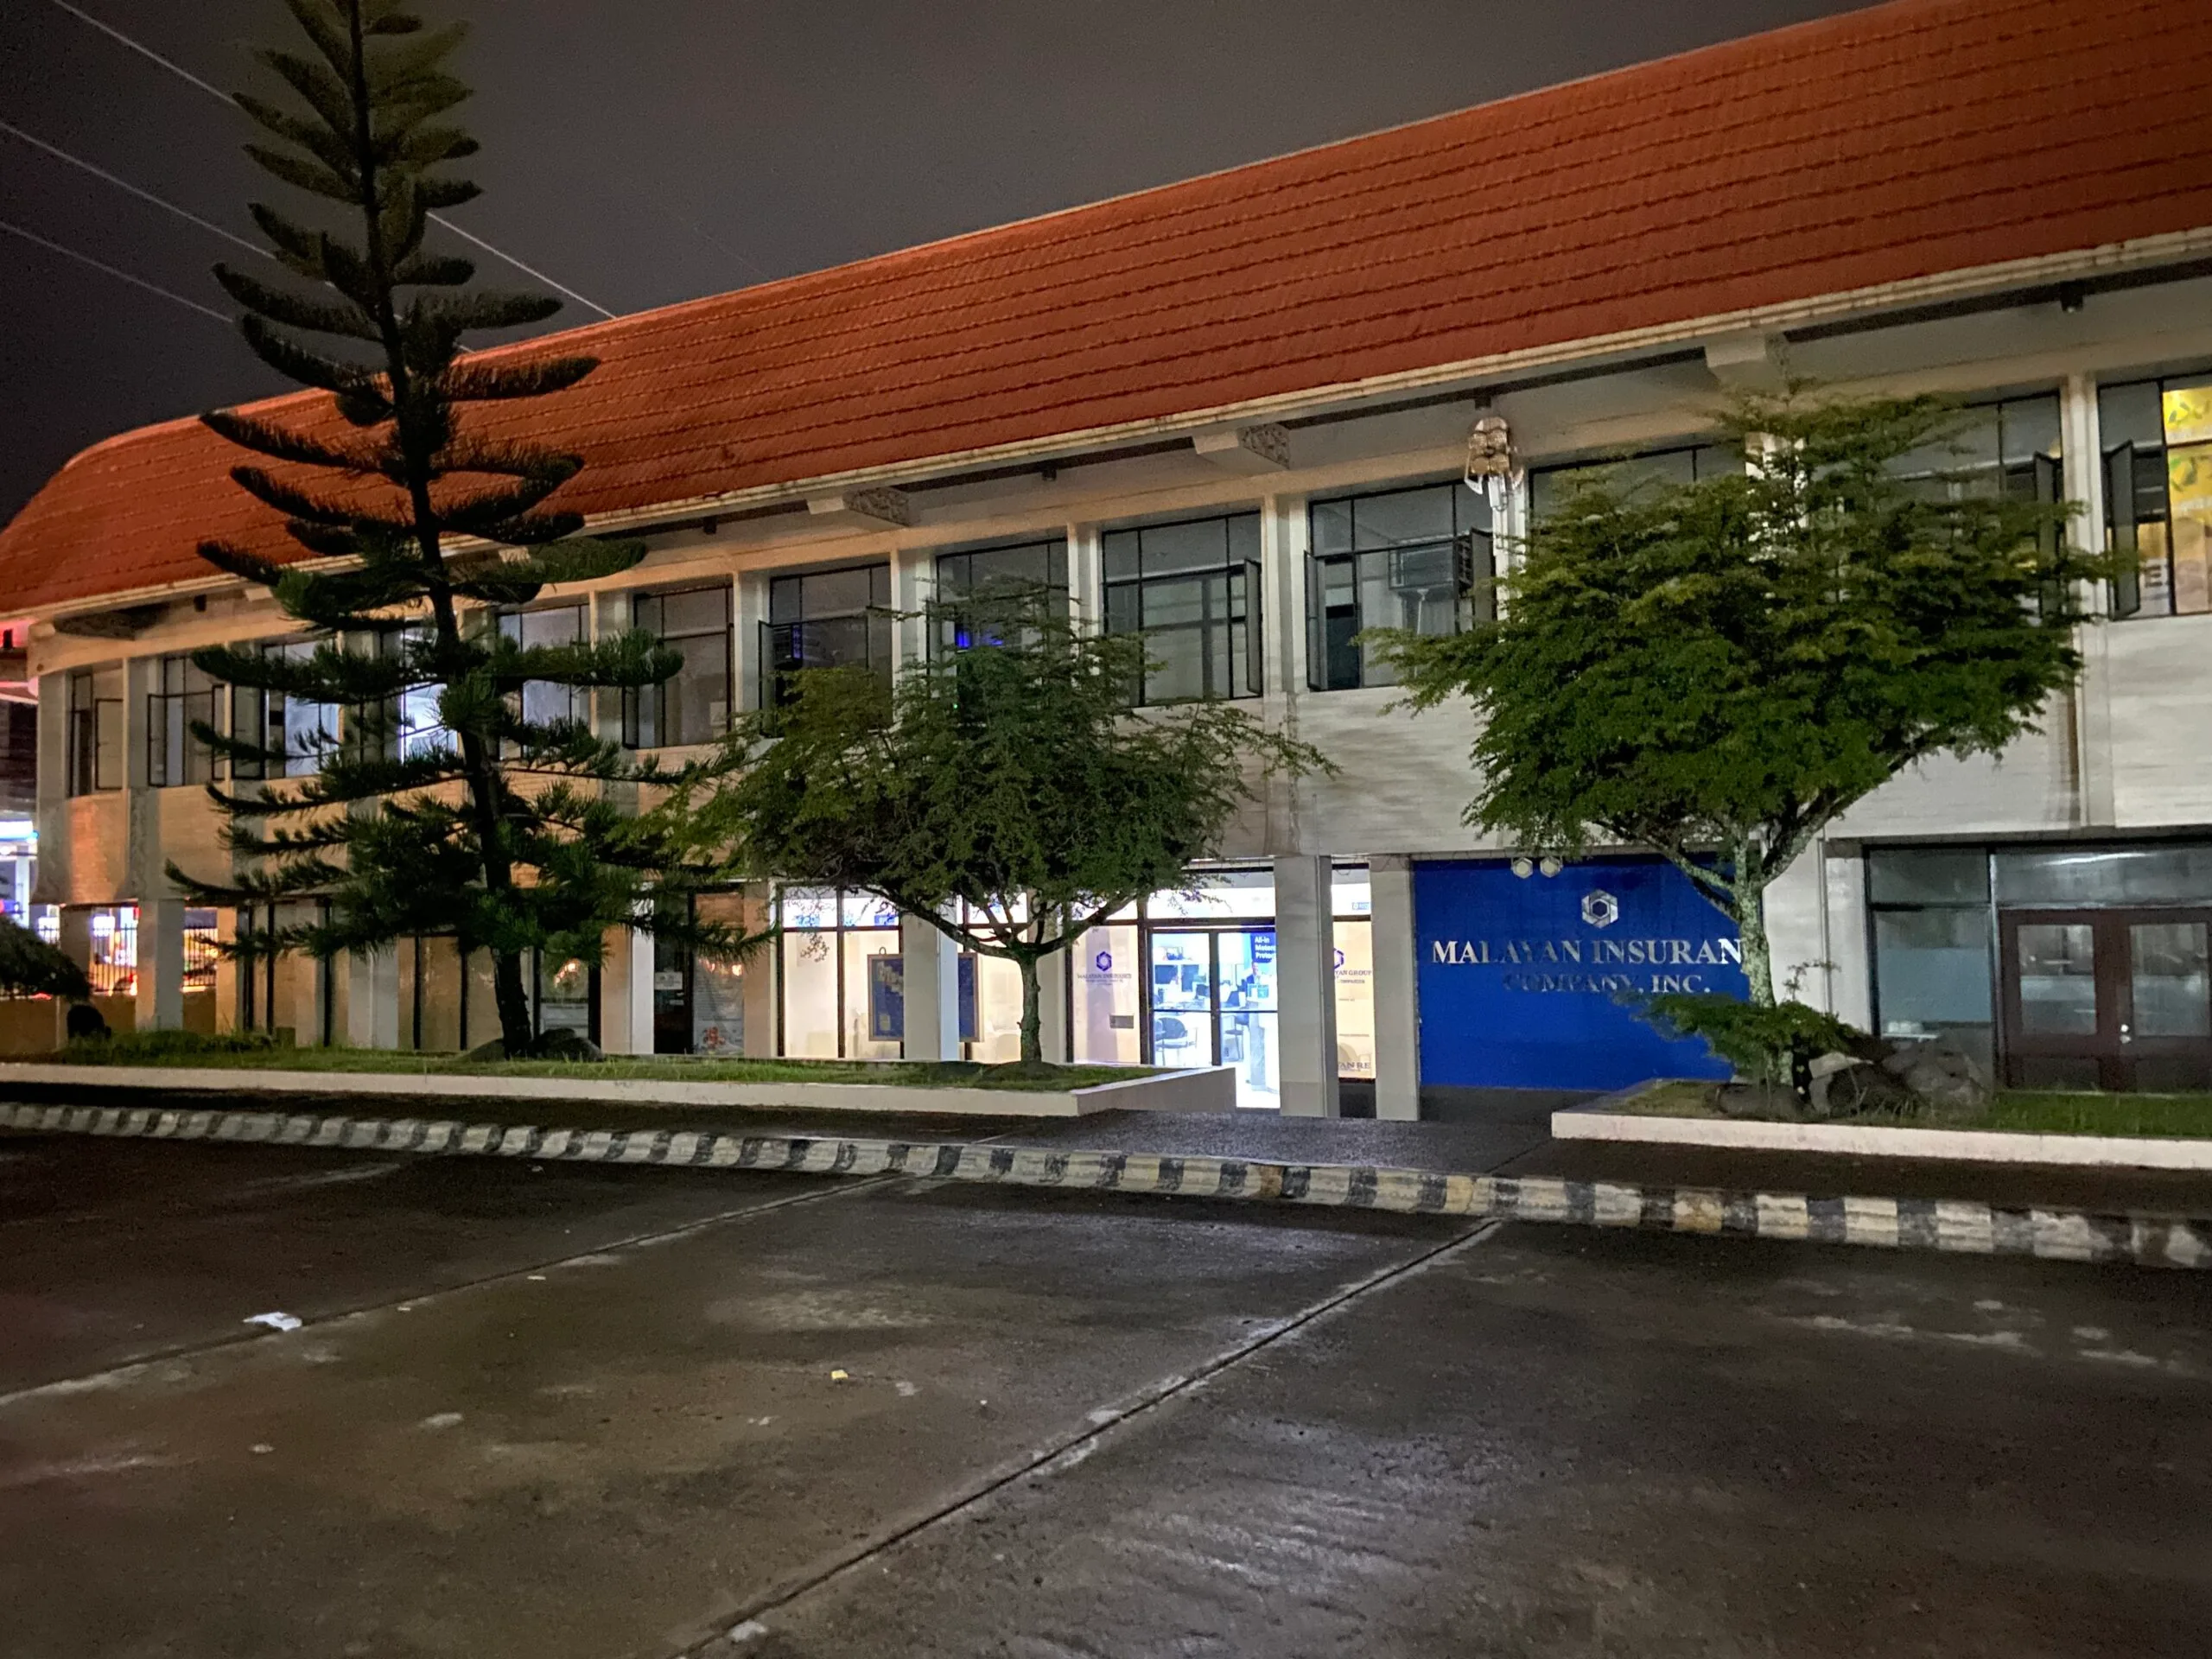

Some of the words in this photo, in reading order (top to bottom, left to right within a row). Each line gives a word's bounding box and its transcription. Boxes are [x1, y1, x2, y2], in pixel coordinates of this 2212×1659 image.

[1431, 939, 1582, 964] MALAYAN
[1591, 938, 1743, 965] INSURAN
[1503, 973, 1643, 995] COMPANY,
[1651, 974, 1711, 994] INC.
